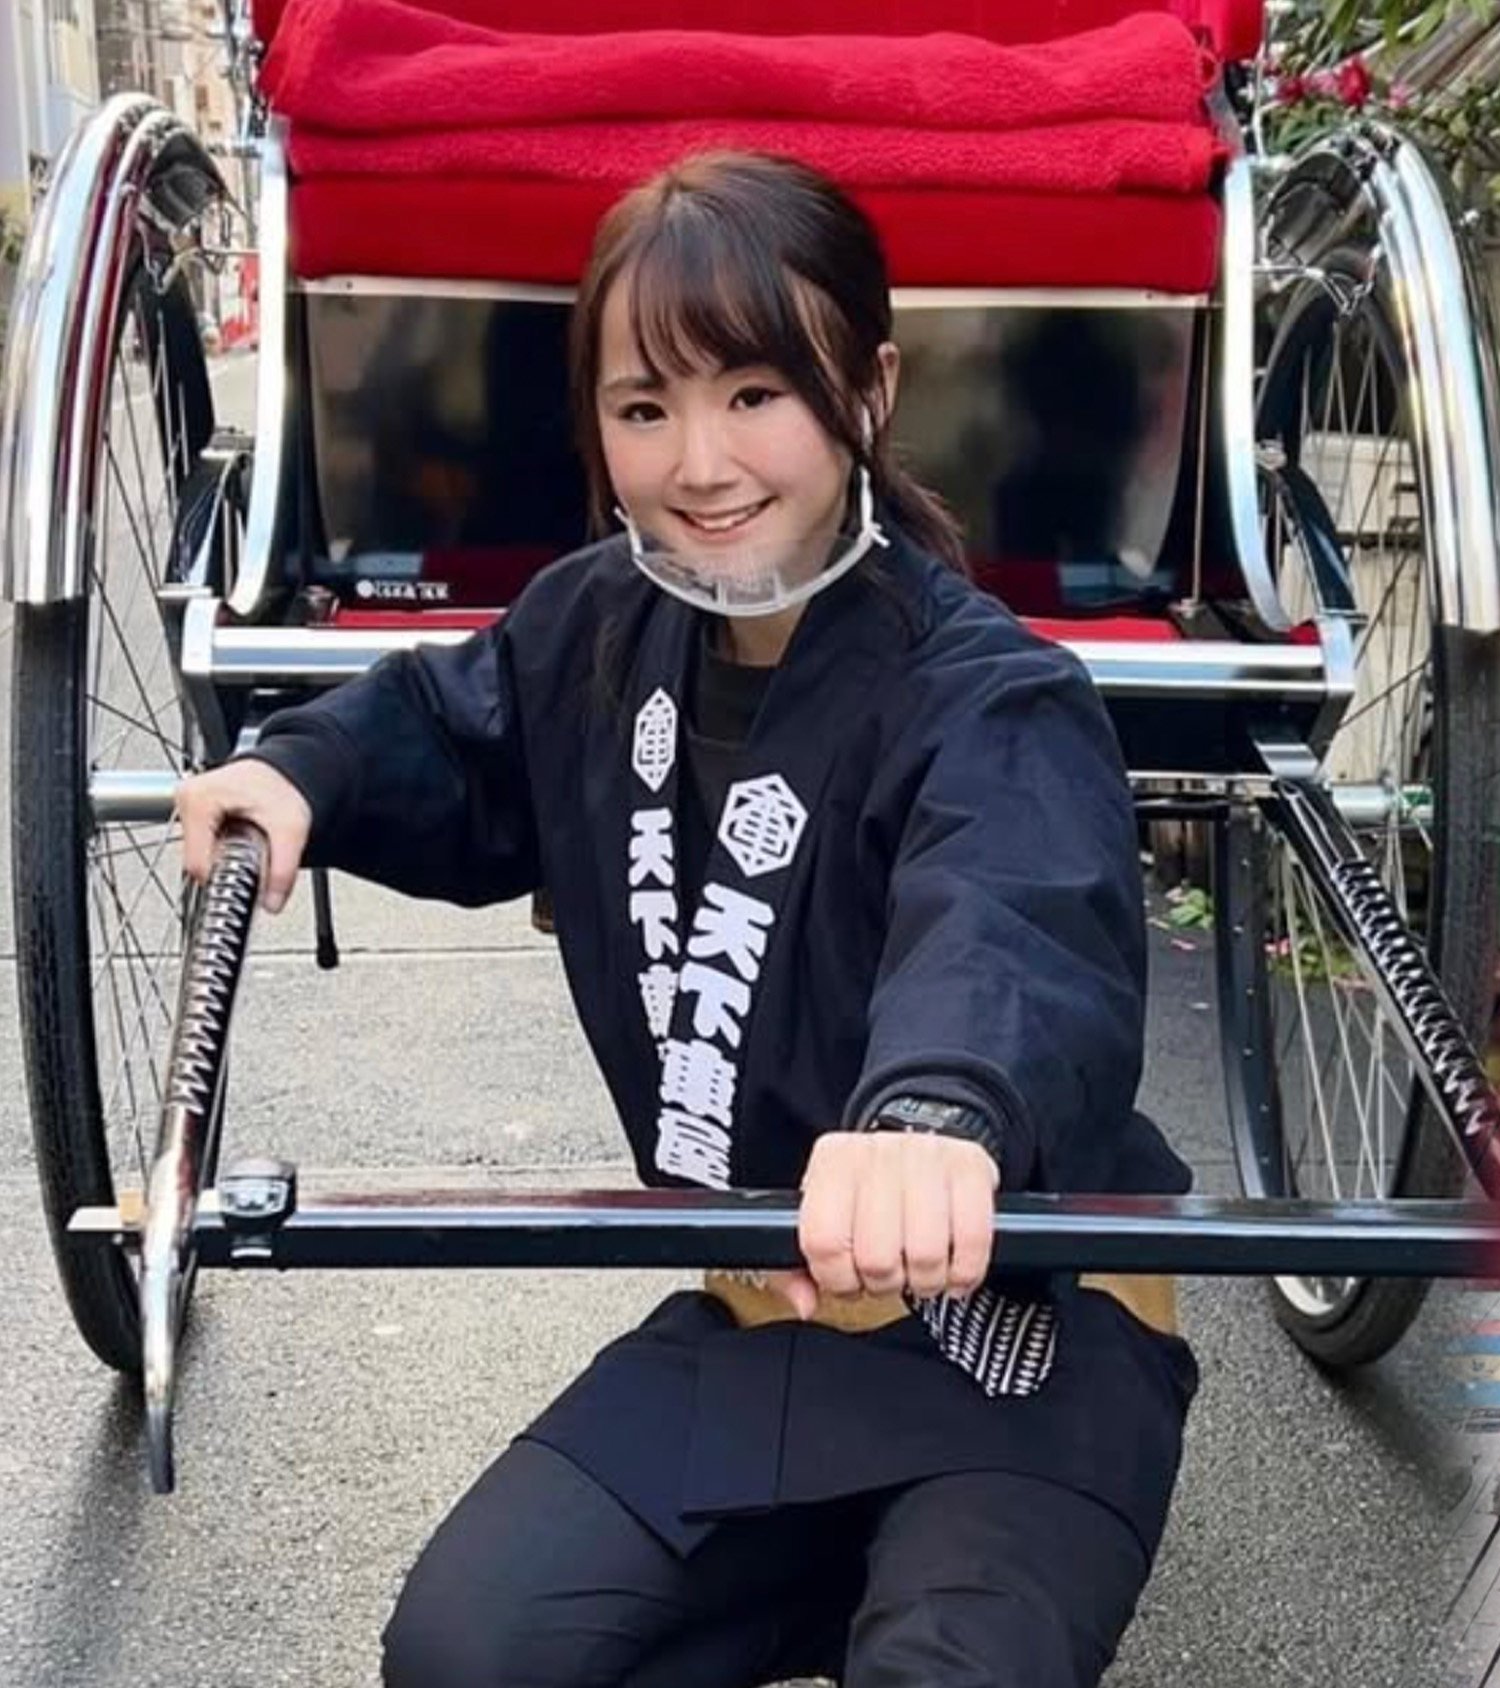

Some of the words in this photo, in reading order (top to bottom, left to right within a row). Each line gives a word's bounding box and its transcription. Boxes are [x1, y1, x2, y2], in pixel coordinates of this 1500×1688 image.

[629, 807, 679, 1062] 天下車
[655, 881, 775, 1192] 天下車屋
